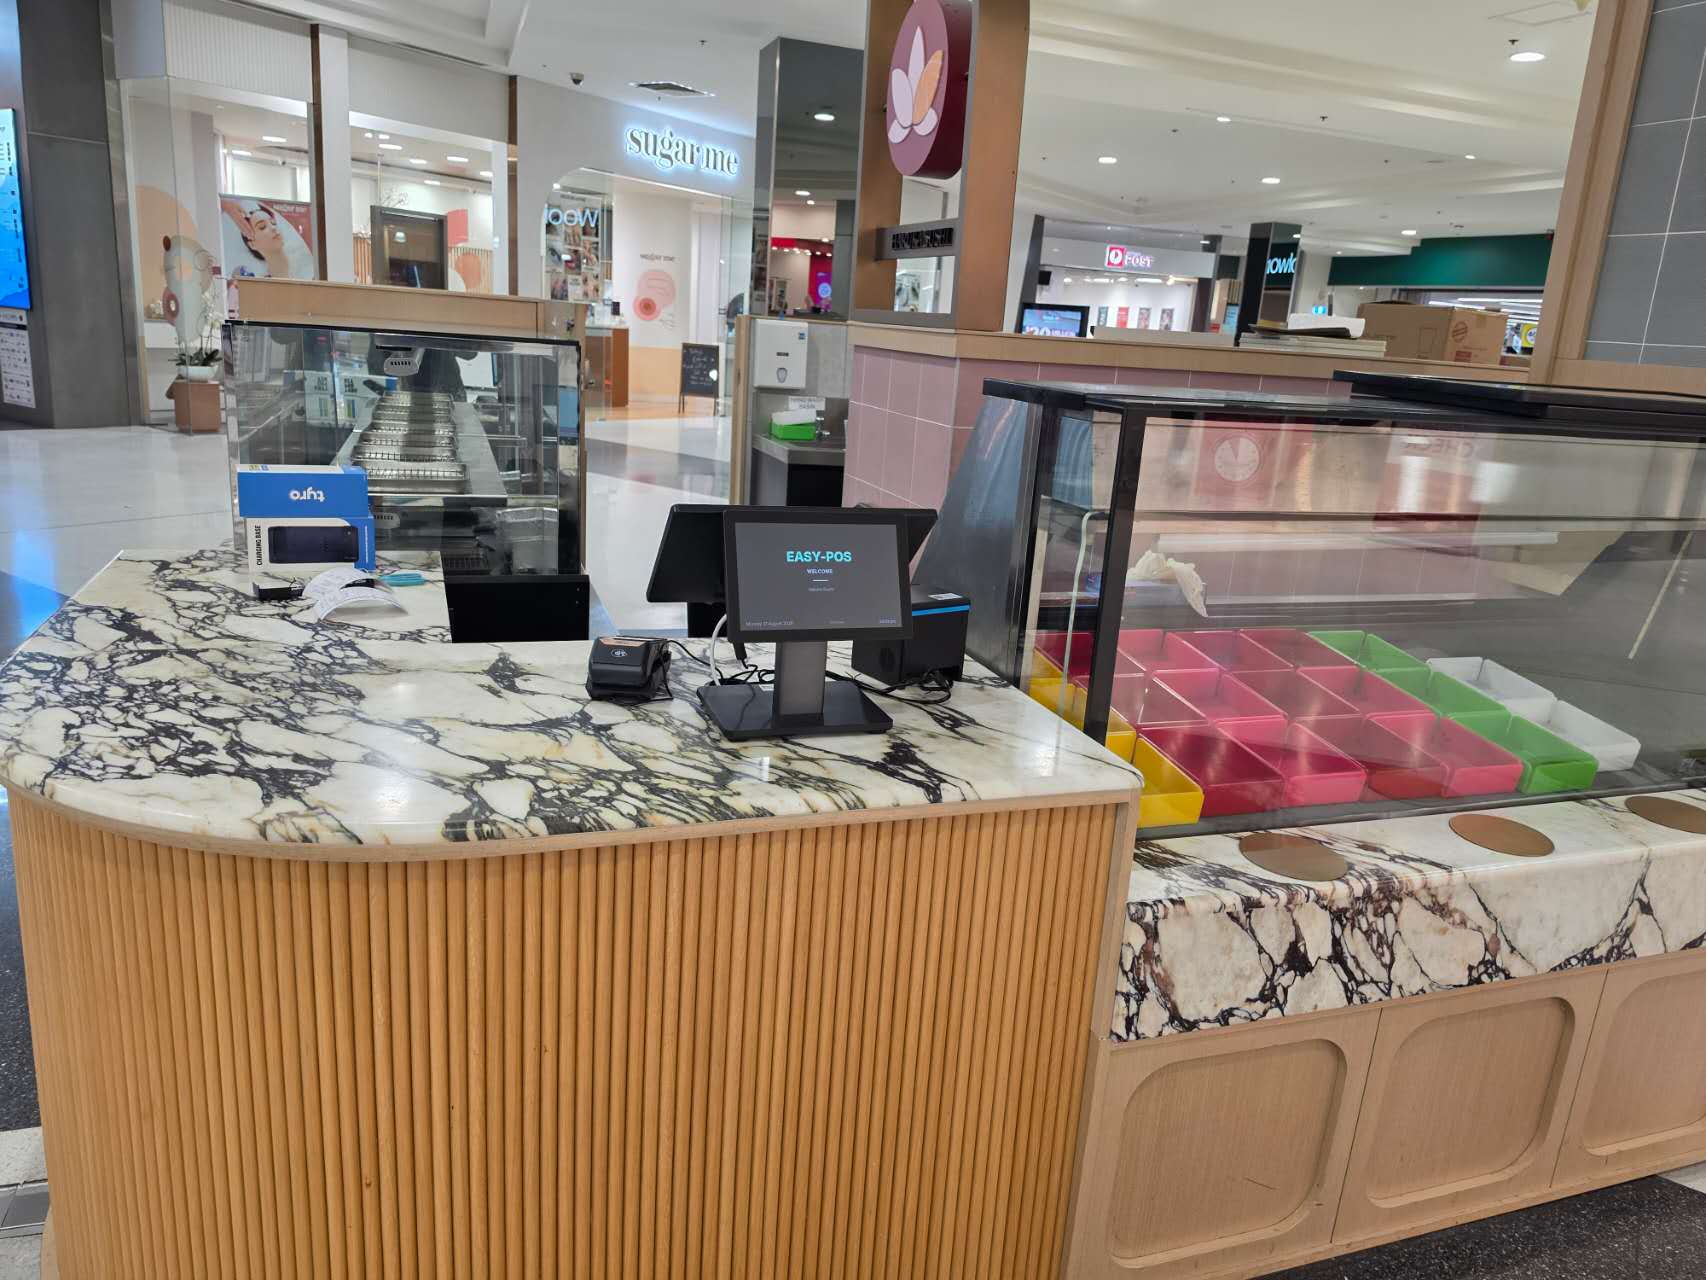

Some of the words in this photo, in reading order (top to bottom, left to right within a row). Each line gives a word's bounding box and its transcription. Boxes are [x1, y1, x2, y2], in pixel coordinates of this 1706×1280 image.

[626, 127, 700, 169] sugar
[701, 144, 739, 176] me
[289, 486, 326, 503] tyro
[254, 525, 262, 538] BASE
[255, 539, 263, 566] CHARGING
[786, 551, 853, 563] EASY-POS
